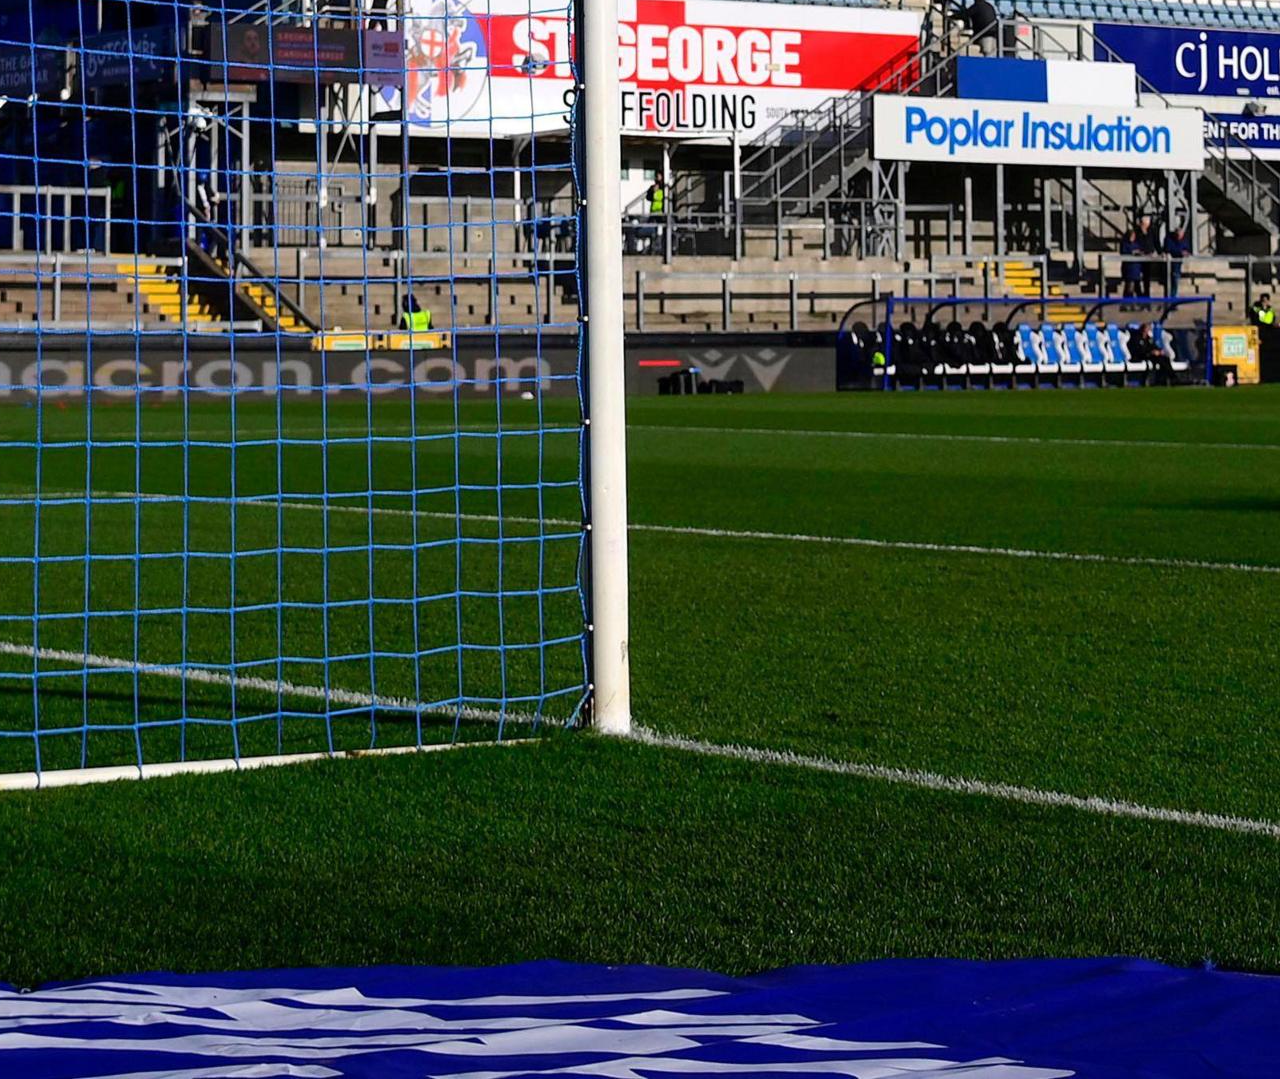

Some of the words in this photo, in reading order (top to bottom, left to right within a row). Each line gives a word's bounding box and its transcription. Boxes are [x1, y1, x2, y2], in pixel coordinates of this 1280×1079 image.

[562, 89, 756, 129] SFFOLDING
[905, 106, 1014, 155] Poplar
[1022, 111, 1171, 153] Insulation
[1230, 122, 1259, 140] FOR
